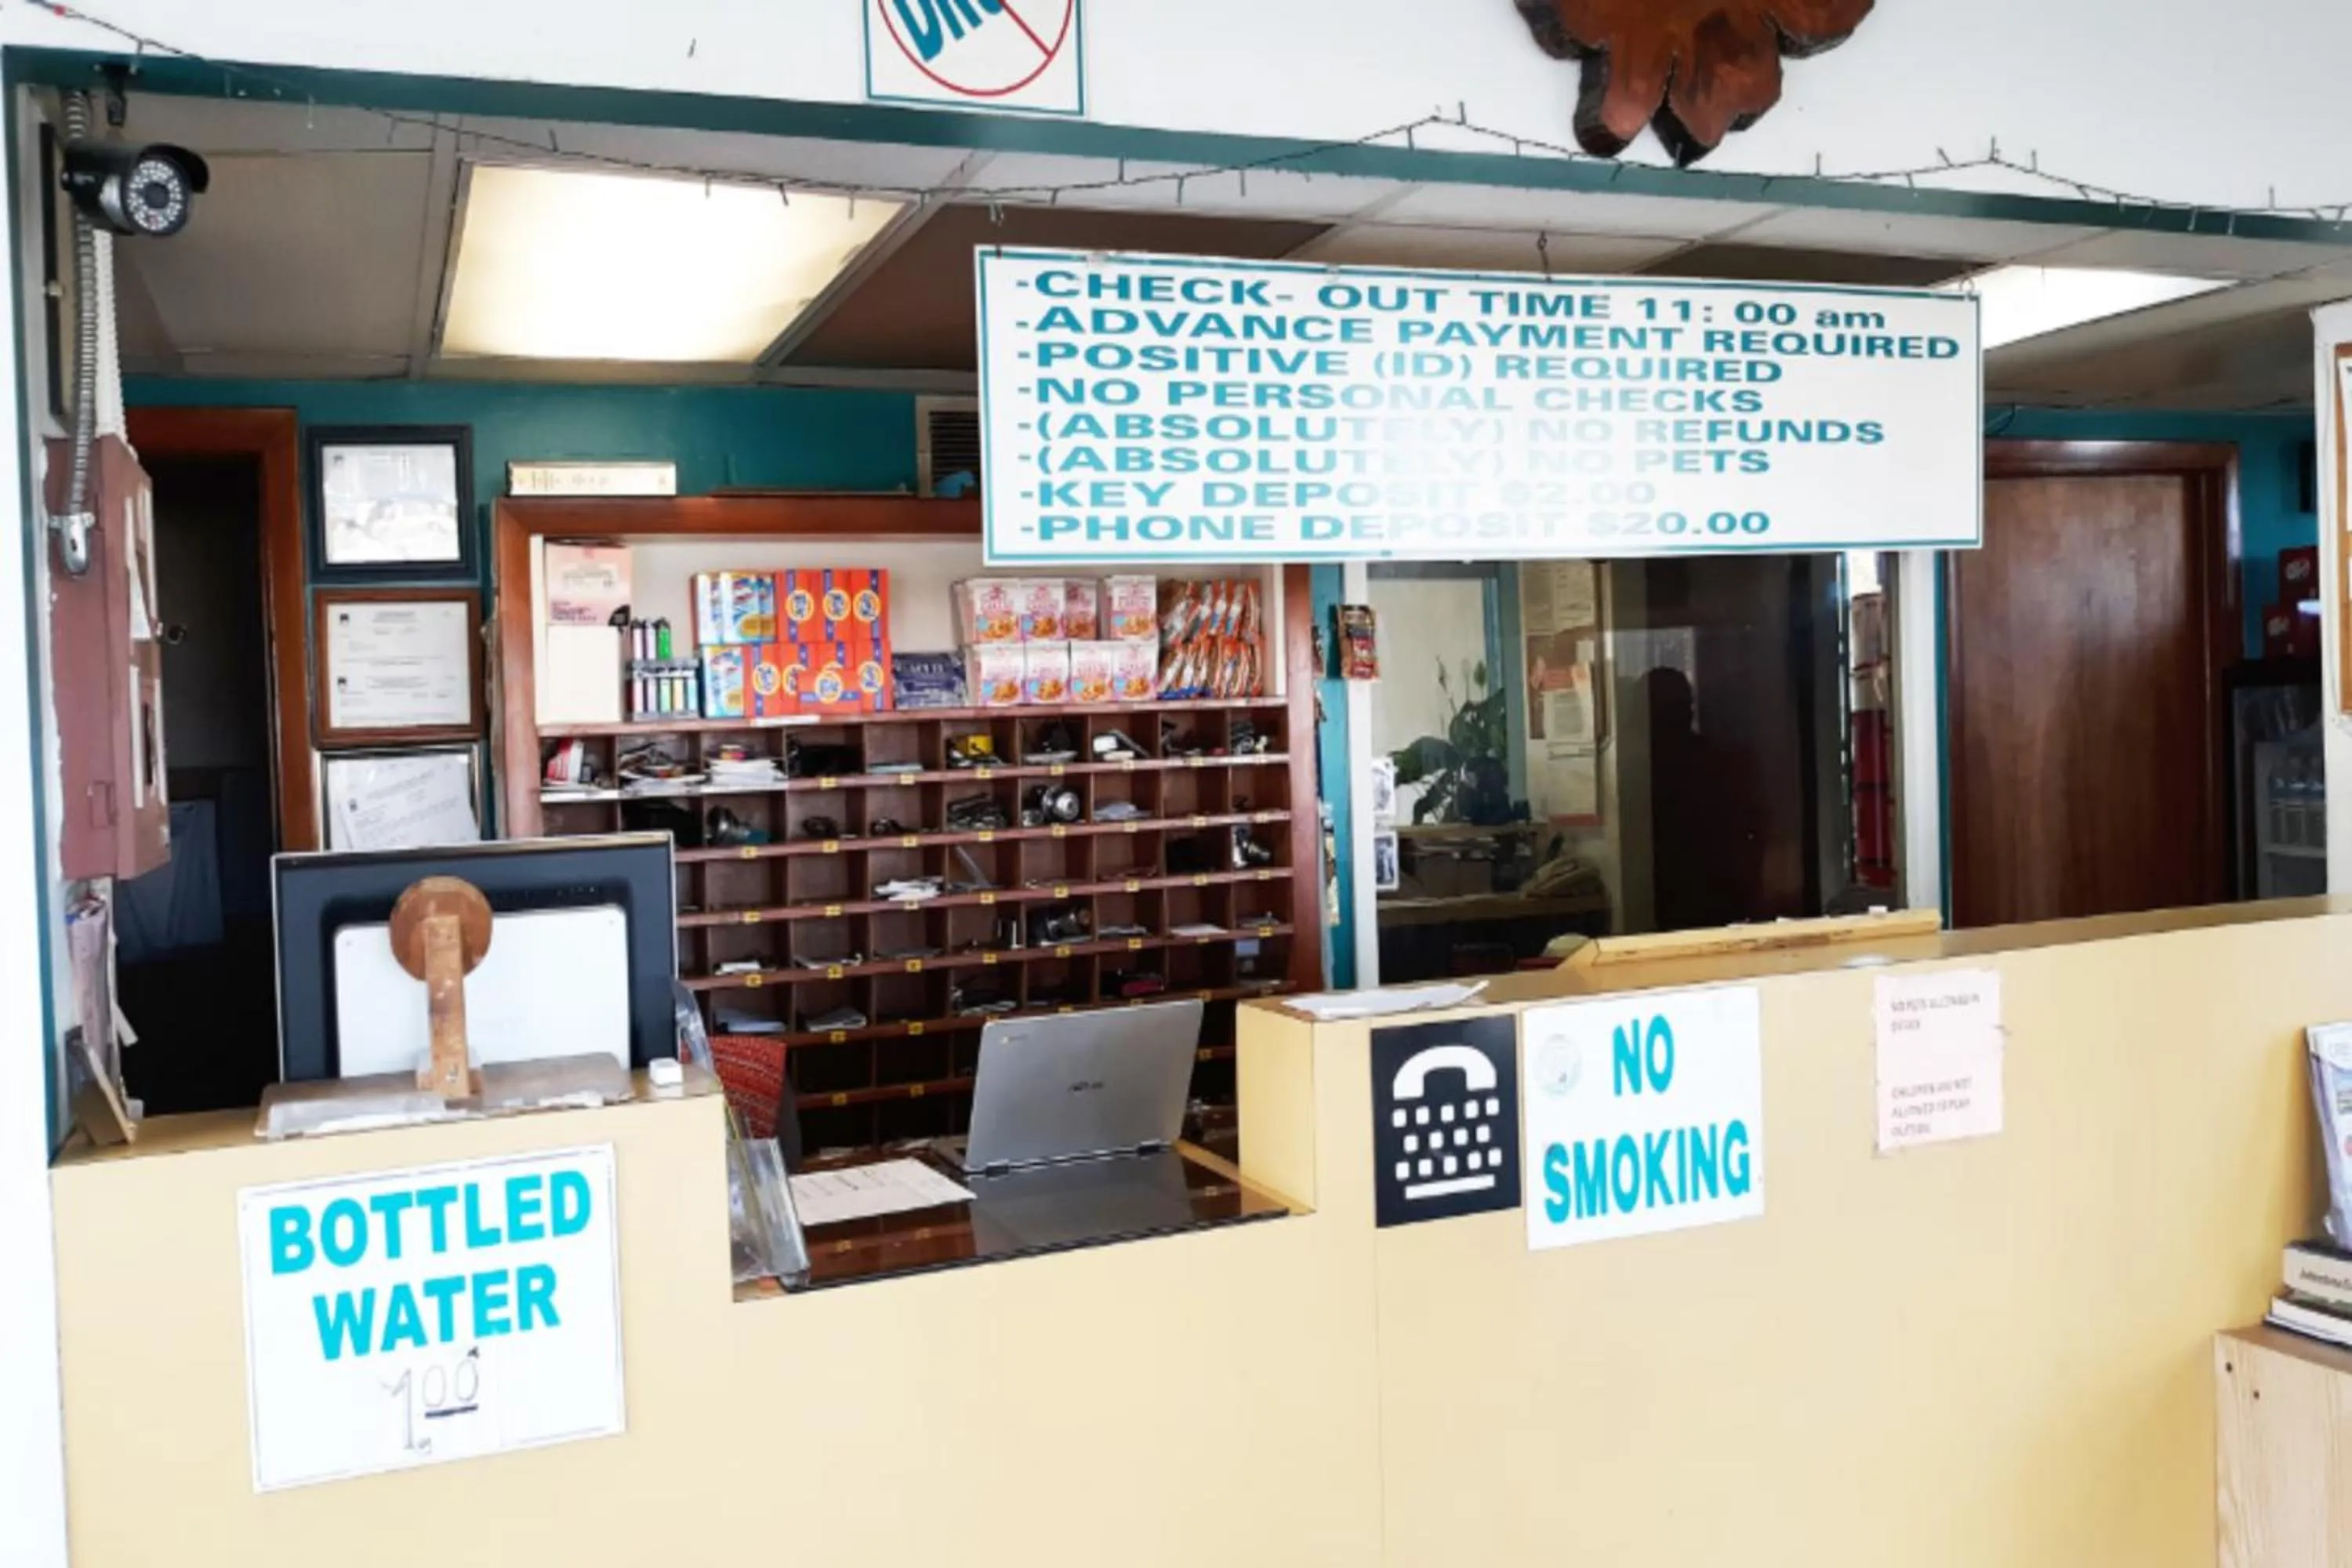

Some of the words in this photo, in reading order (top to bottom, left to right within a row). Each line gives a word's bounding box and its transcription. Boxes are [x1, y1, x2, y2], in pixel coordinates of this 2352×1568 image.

[1318, 283, 1450, 313] OUT
[1468, 290, 1611, 319] TIME
[1815, 309, 1886, 329] am
[1398, 319, 1683, 351] PAYMENT
[1704, 328, 1960, 360] REQUIRED
[1372, 350, 1473, 380] (ID)
[1495, 354, 1783, 383] REQUIRED
[1167, 381, 1514, 409] PERSONAL
[1534, 387, 1764, 414] CHECKS
[1528, 418, 1613, 444] NO
[1635, 418, 1885, 445] REFUNDS
[1527, 449, 1613, 474] NO
[1635, 449, 1772, 474] PETS
[1203, 480, 1480, 509] DEPOSIT
[1301, 511, 1565, 541] DEPOSIT
[1586, 510, 1770, 539] $20.00
[1613, 1014, 1675, 1097] NO
[1543, 1120, 1751, 1225] SMOKING
[269, 1171, 592, 1276] BOTTLED
[312, 1263, 561, 1361] WATER
